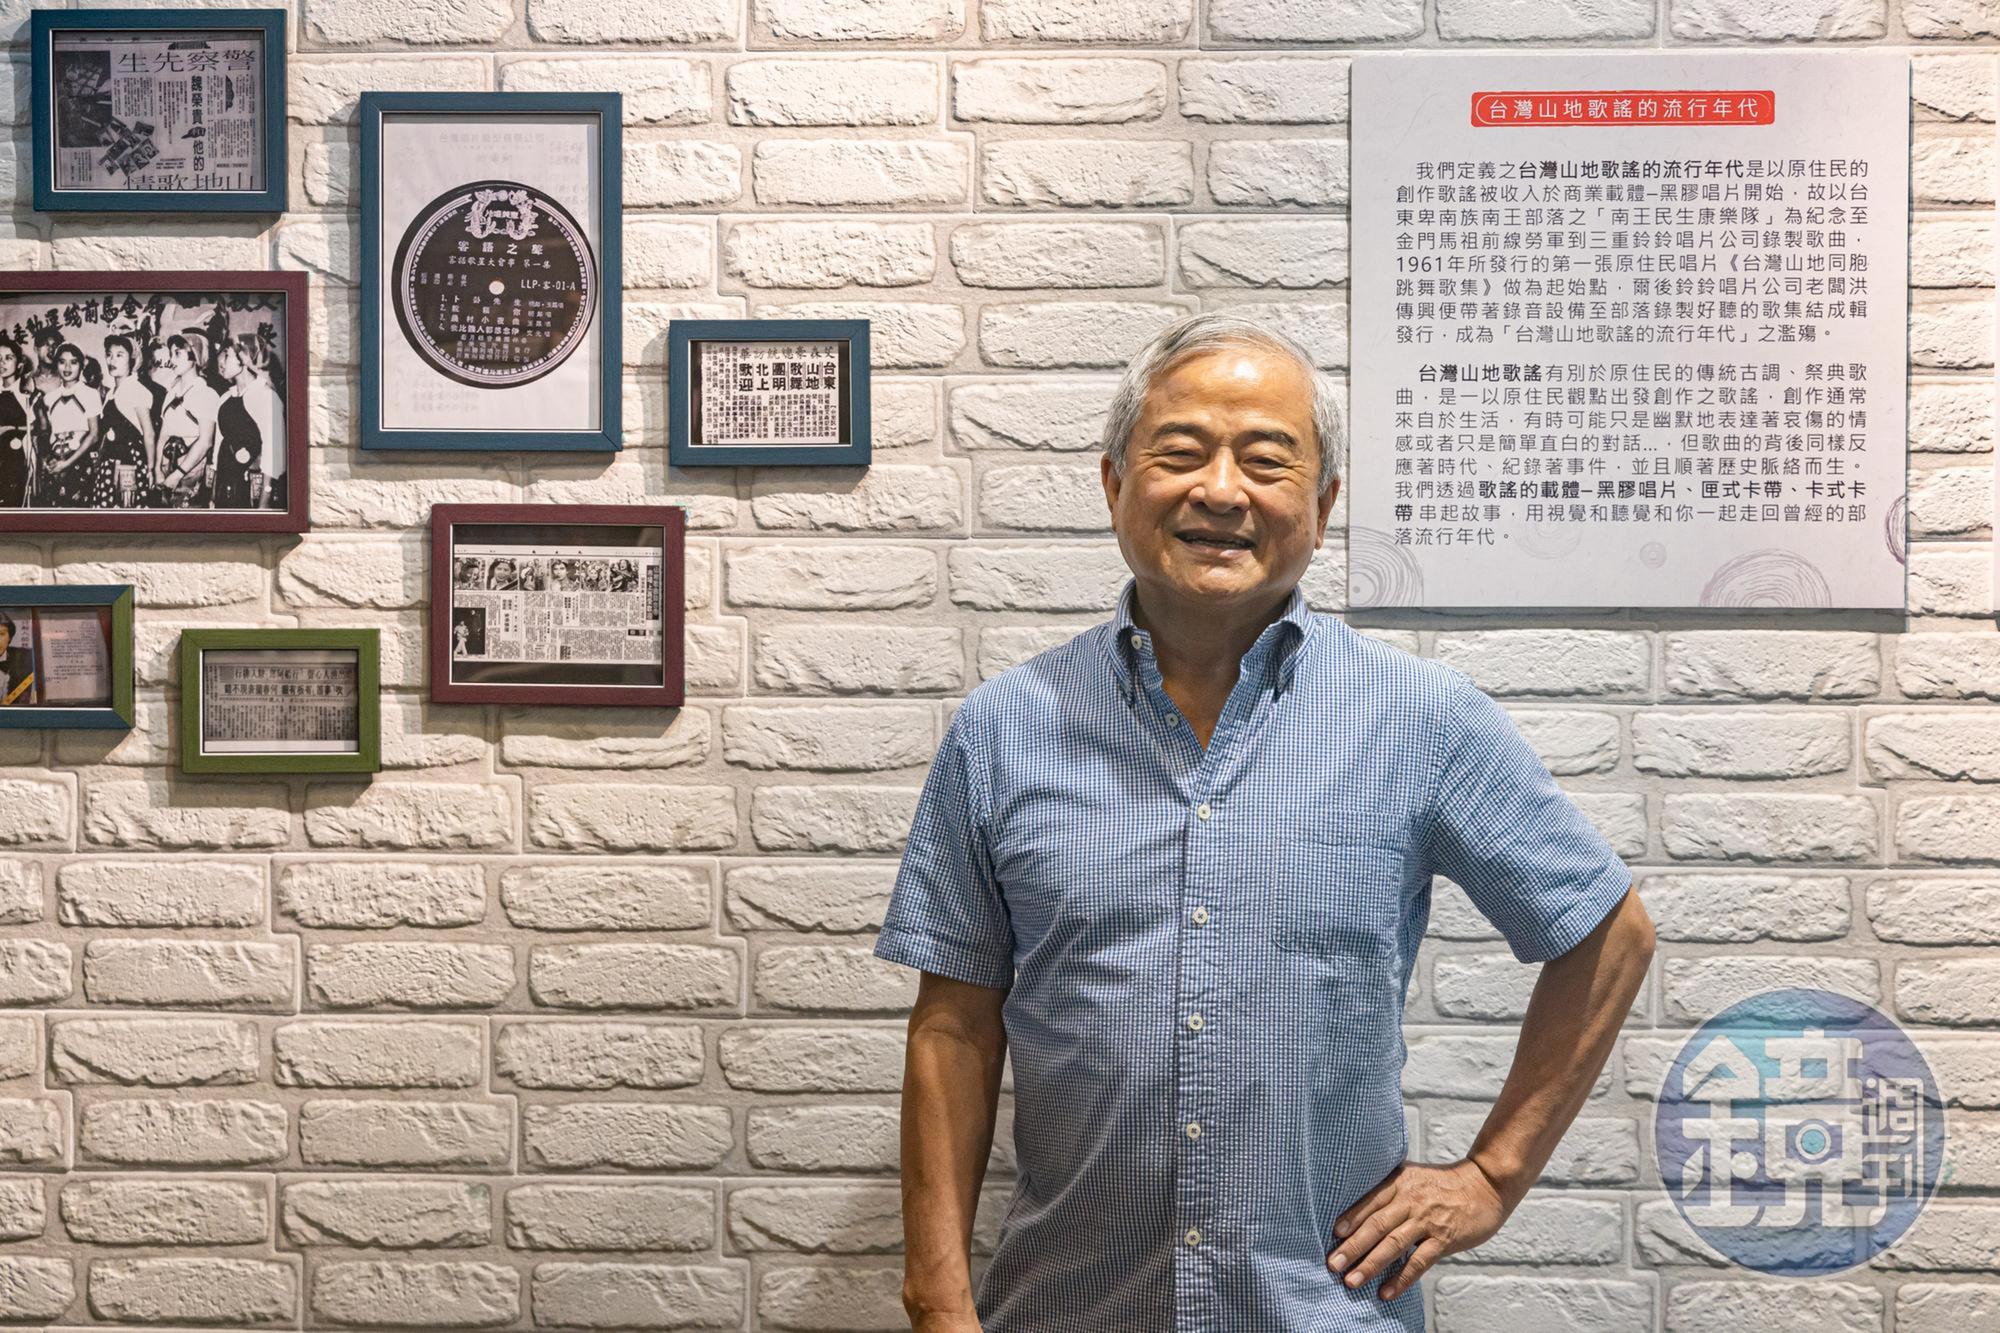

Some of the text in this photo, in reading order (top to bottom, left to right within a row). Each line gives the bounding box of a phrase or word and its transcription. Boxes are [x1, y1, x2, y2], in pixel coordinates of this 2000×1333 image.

[1489, 98, 1759, 119] 台灣山地歌謠的流行年代
[1416, 160, 1868, 179] 我們定義之台灣山地歌謠的流行年代是以原住民的
[1396, 301, 1867, 320] 傳興便帶著錄音設備至部落錄製好聽的歌集結成輯
[1394, 528, 1510, 545] 落流行年代。
